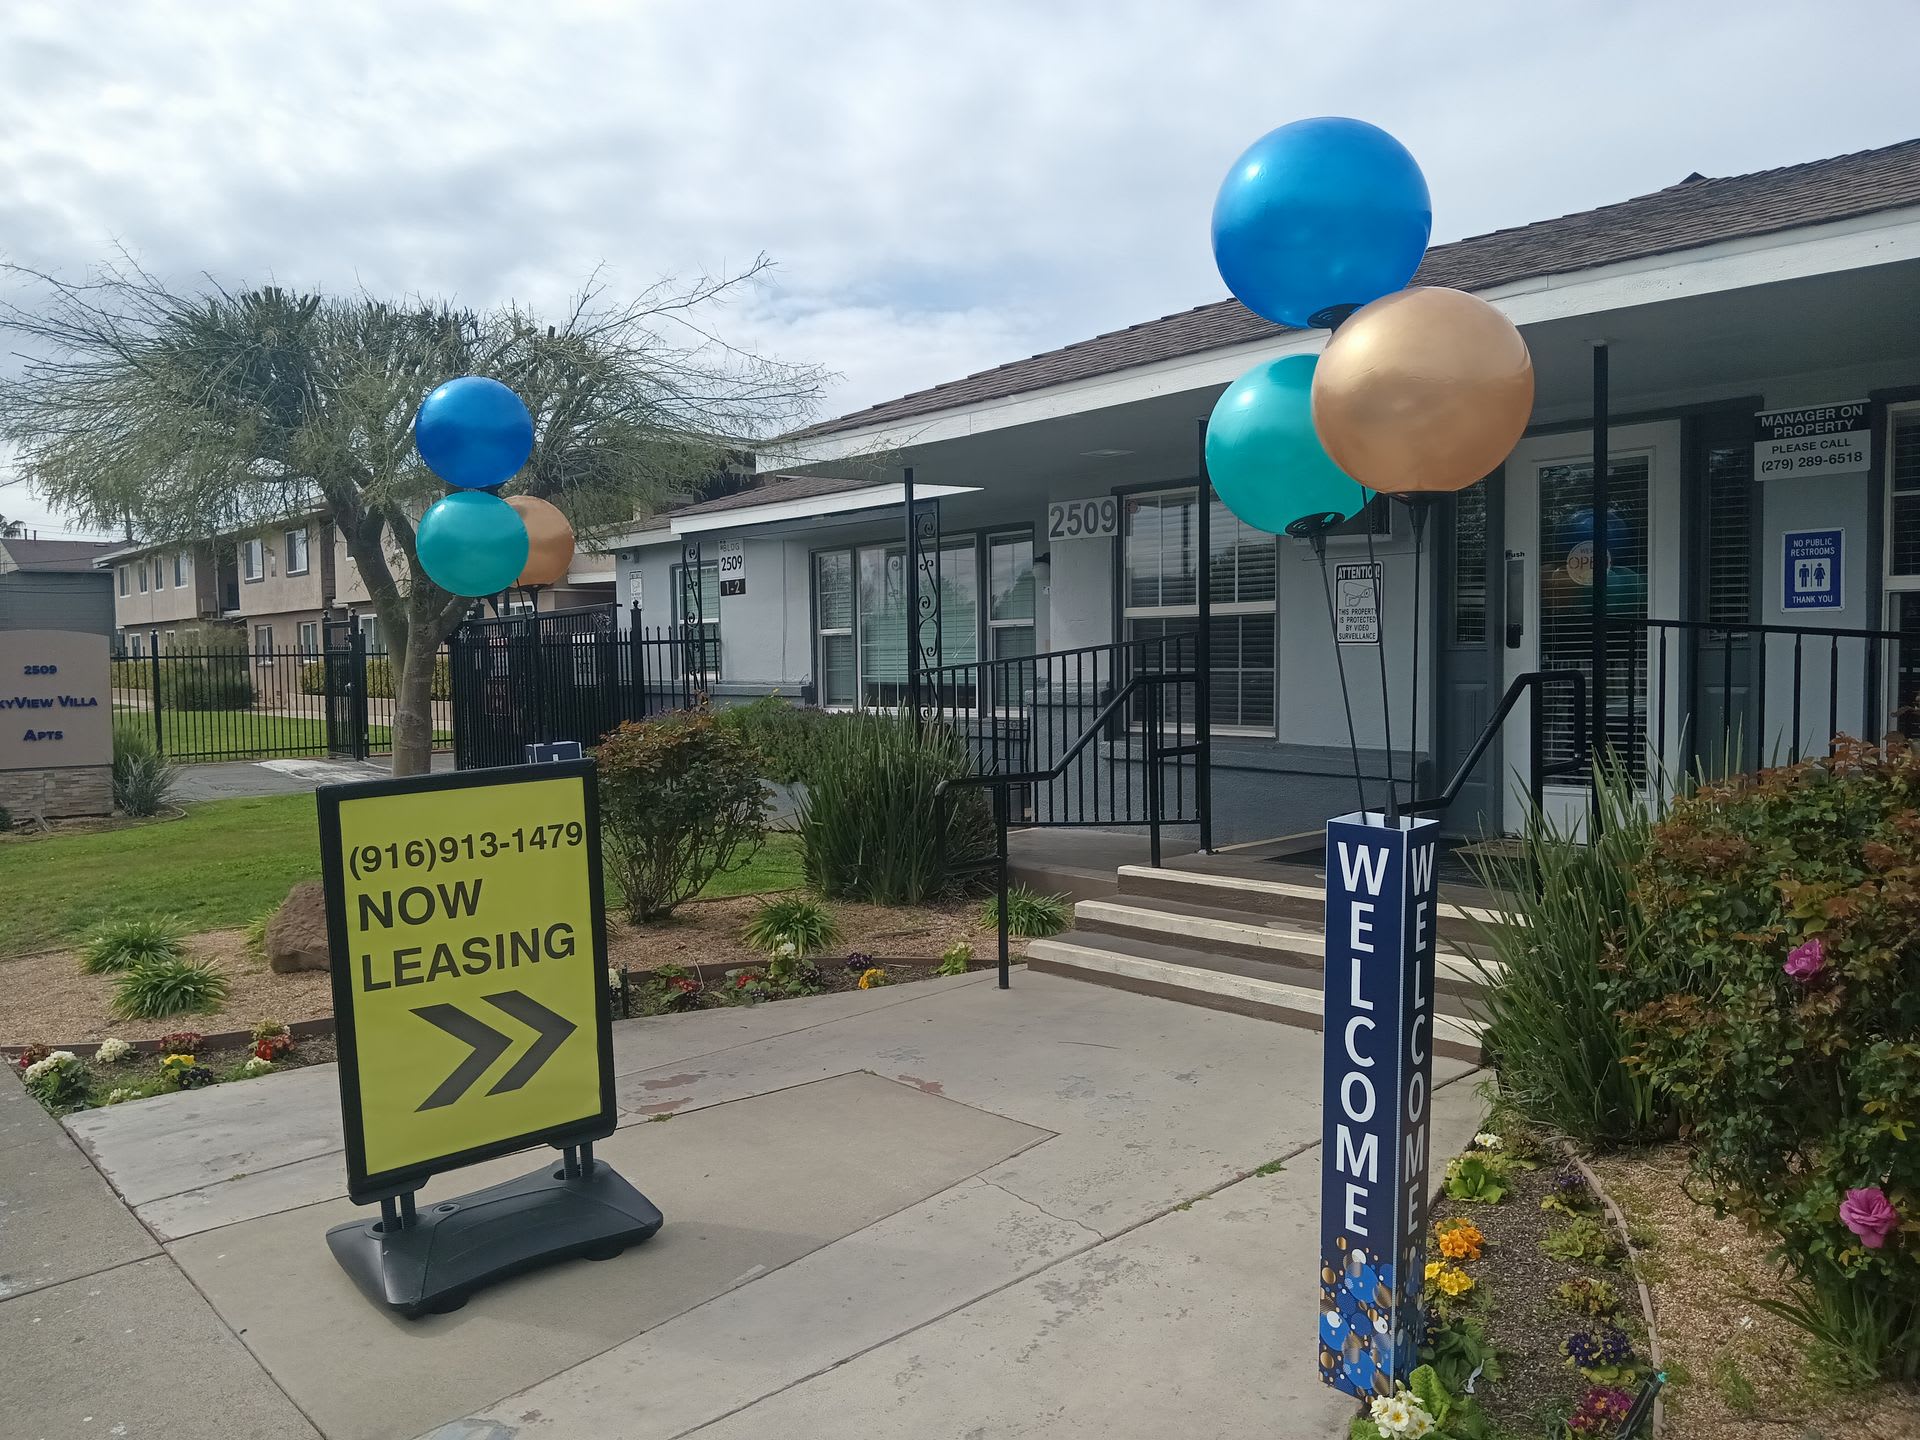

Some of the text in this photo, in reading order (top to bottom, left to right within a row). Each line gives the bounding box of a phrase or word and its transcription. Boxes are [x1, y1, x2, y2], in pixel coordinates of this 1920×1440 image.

[1761, 405, 1864, 427] MANAGER ON
[1774, 419, 1855, 438] PROPERTY
[1772, 438, 1852, 454] PLEASE CALL
[1761, 452, 1863, 473] (279) 289-6518
[1050, 500, 1116, 537] 2509
[1793, 537, 1833, 548] NO PUBLIC
[1790, 547, 1835, 557] RESTROOMS
[721, 555, 743, 571] 2509
[1338, 566, 1380, 580] ATTENTIO!
[726, 581, 740, 595] 1-2
[1792, 594, 1833, 604] THANK YOU
[1339, 632, 1376, 640] SURVEILLANCE
[24, 665, 57, 674] 2509
[350, 821, 583, 881] (916)913-1479
[358, 878, 483, 932] NOW
[362, 922, 576, 993] LEASING
[1336, 841, 1390, 1236] WELCOME
[1405, 841, 1434, 1235] WELCOME
